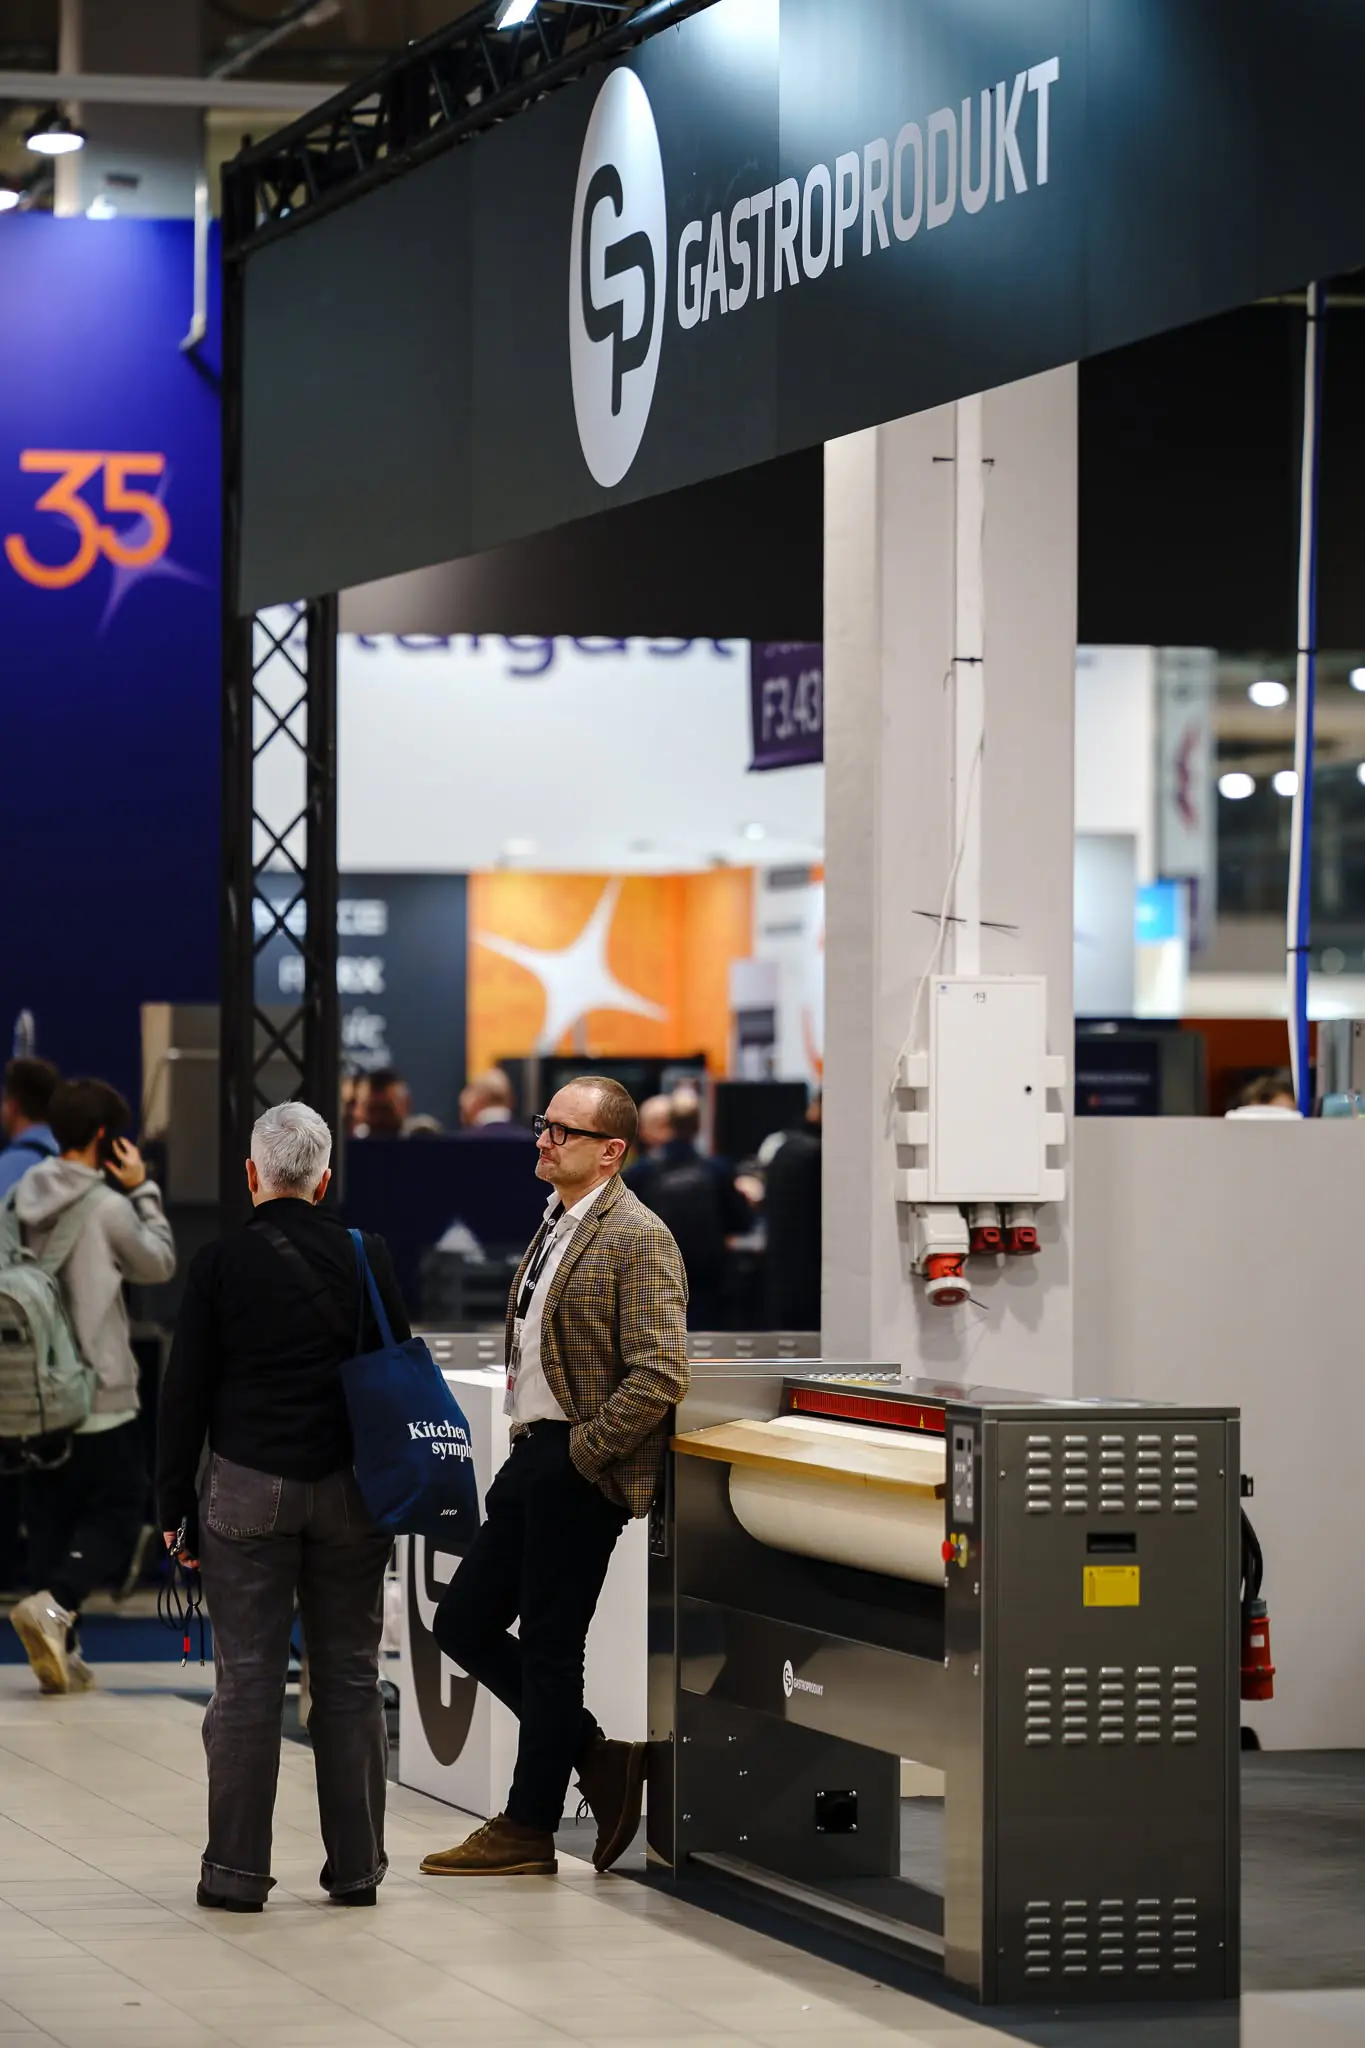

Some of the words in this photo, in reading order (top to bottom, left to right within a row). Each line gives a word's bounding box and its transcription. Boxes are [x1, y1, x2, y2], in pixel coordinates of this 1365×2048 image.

[677, 56, 1060, 330] GASTROPRODUKT
[4, 449, 171, 588] 35
[407, 1420, 467, 1440] Kitchen
